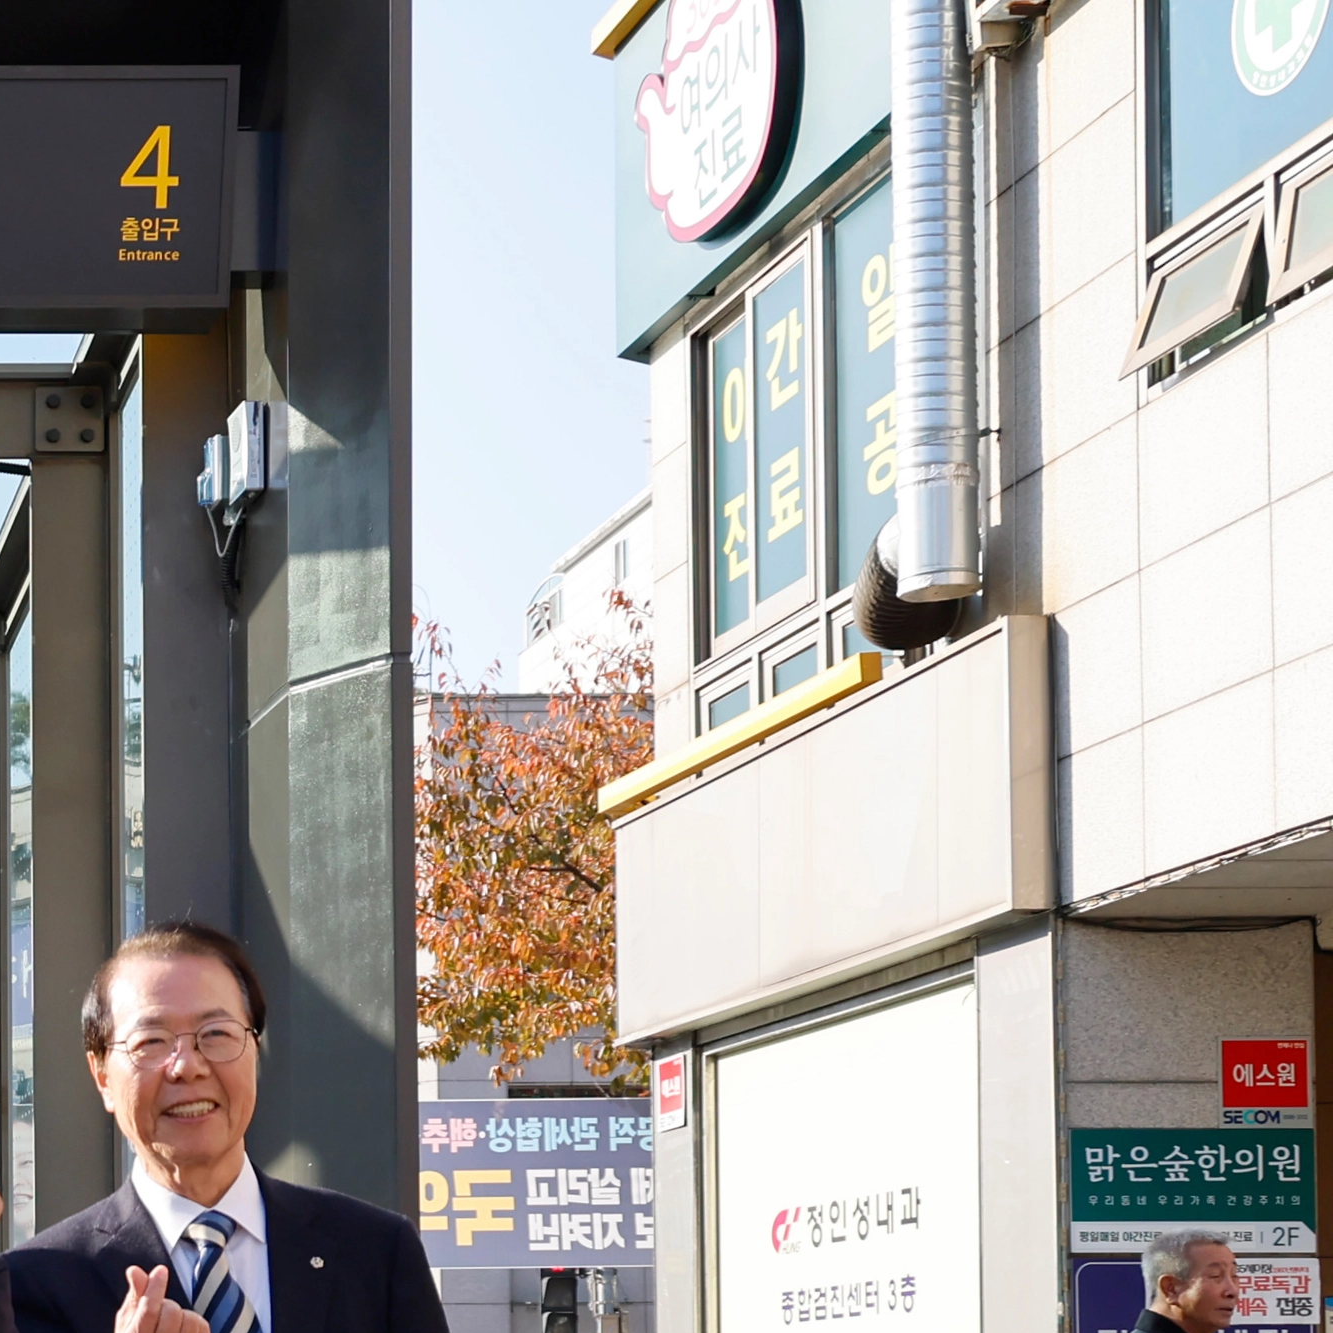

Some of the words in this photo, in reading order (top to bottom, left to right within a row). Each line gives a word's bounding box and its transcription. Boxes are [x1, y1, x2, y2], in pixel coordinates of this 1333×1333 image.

[680, 4, 761, 134] 여의사
[120, 124, 180, 209] 4
[694, 104, 747, 209] 진료
[120, 216, 181, 242] 출입구
[119, 248, 181, 262] Entrance
[1233, 1063, 1296, 1087] 에스원
[1223, 1110, 1280, 1124] SECOM
[1085, 1144, 1301, 1182] 맑은숲한의원
[1088, 1195, 1147, 1206] 우리동네
[1158, 1195, 1216, 1206] 우리가족
[1227, 1195, 1301, 1206] 건강주치의
[807, 1186, 921, 1248] 정인성내과
[1079, 1230, 1120, 1242] 평일매일
[1123, 1230, 1163, 1242] 야간진료
[1233, 1230, 1253, 1242] 진료
[1272, 1227, 1299, 1246] 2F
[1239, 1276, 1311, 1294] 무료독감
[782, 1280, 879, 1325] 종합검진센터
[888, 1274, 916, 1313] 3층
[1276, 1297, 1314, 1316] 접종
